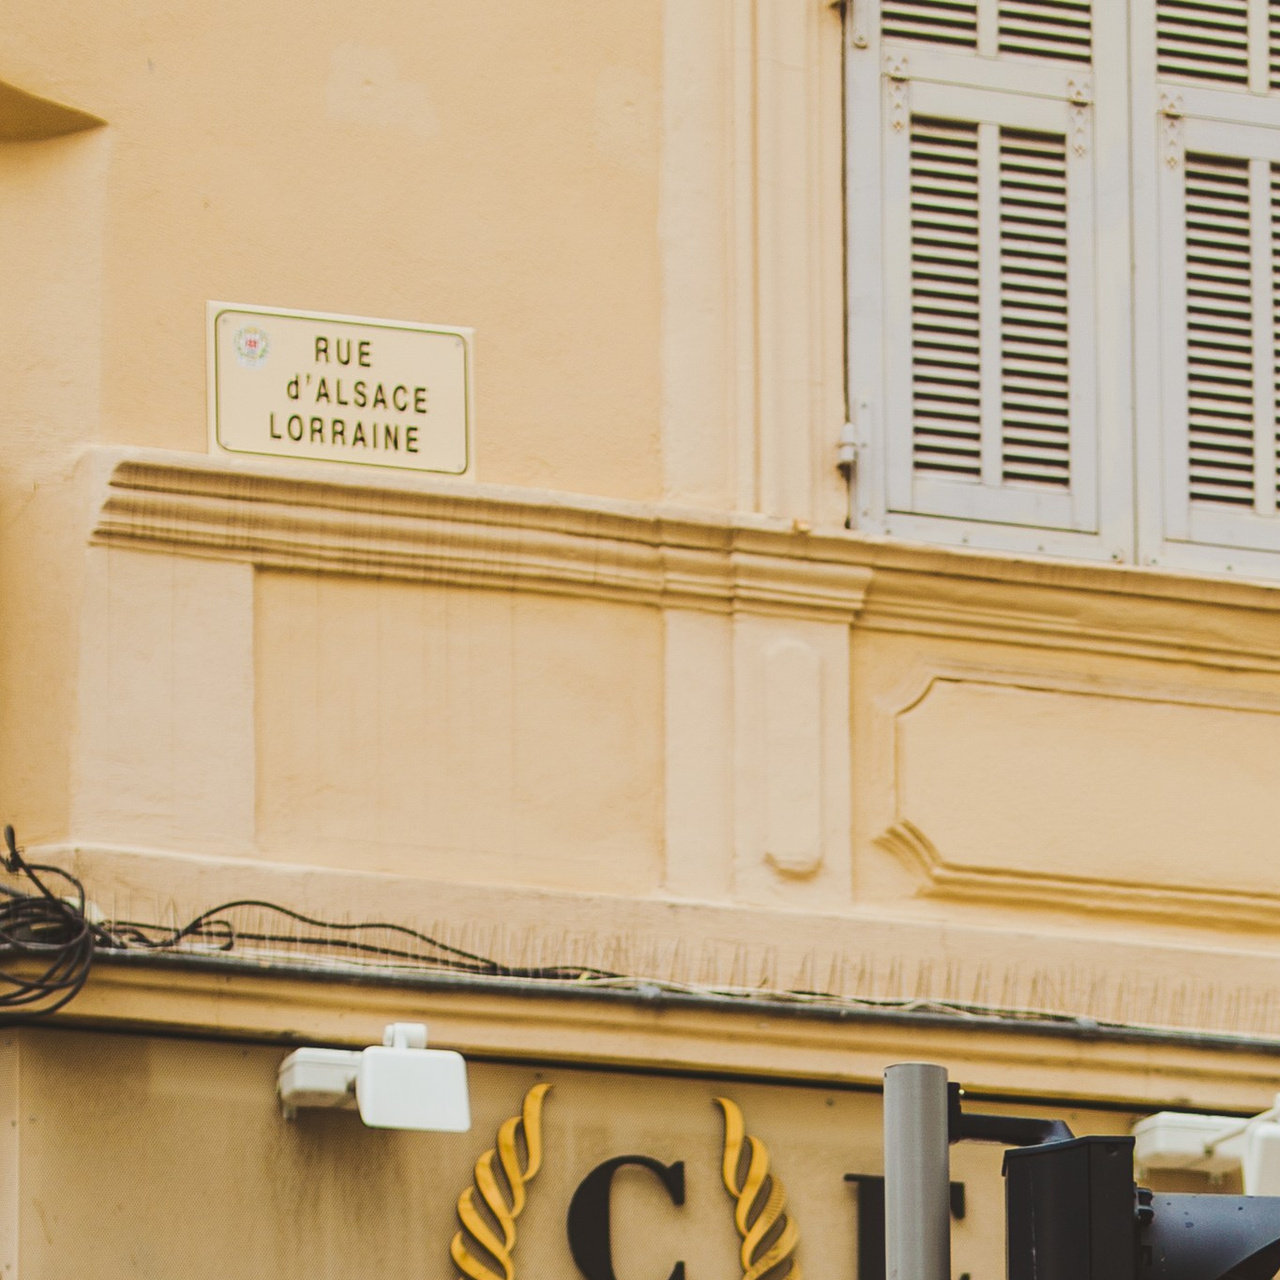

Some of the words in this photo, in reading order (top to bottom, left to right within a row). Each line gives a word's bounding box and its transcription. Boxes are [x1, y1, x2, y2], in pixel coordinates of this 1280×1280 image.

[314, 336, 372, 368] RUE
[286, 373, 428, 414] d'ALSACE
[269, 412, 419, 453] LORRAINE
